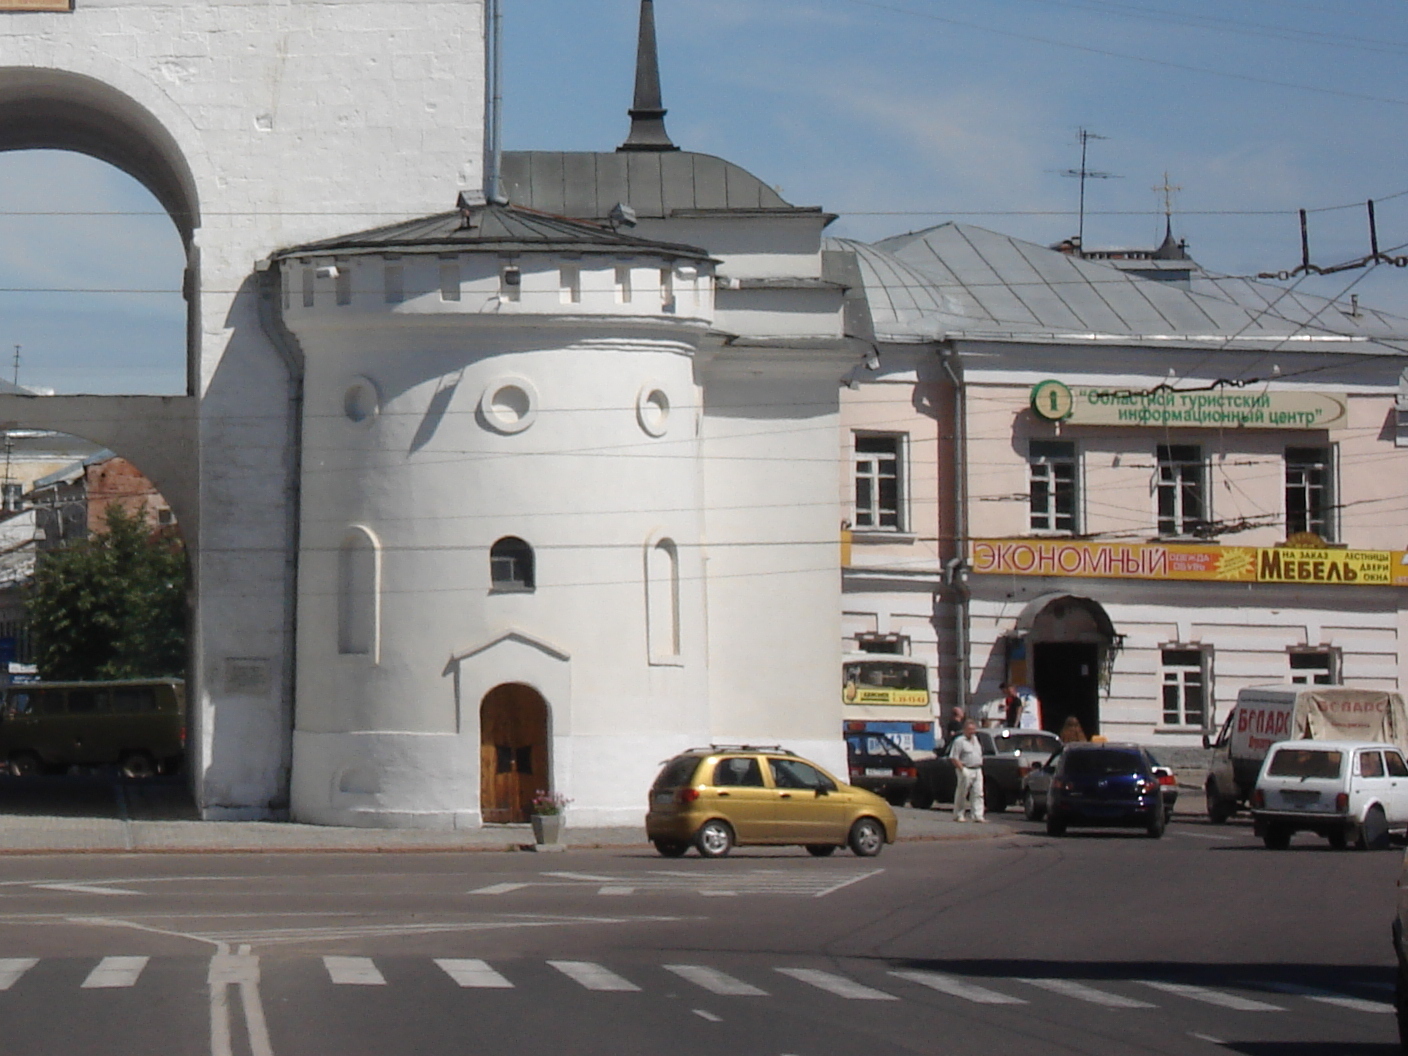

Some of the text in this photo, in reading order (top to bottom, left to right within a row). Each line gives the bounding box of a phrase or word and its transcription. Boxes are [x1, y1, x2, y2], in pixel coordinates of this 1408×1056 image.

[1180, 393, 1270, 409] туристский
[1118, 408, 1264, 425] информационный
[975, 543, 1168, 576] ЭКОНОМНЫЙ
[1282, 551, 1329, 560] НА ЗАКАЗ
[1344, 552, 1389, 562] ЛЕСТНИЦЫ
[1359, 563, 1389, 572] ДВЕРИ
[1363, 572, 1389, 582] ОКНА
